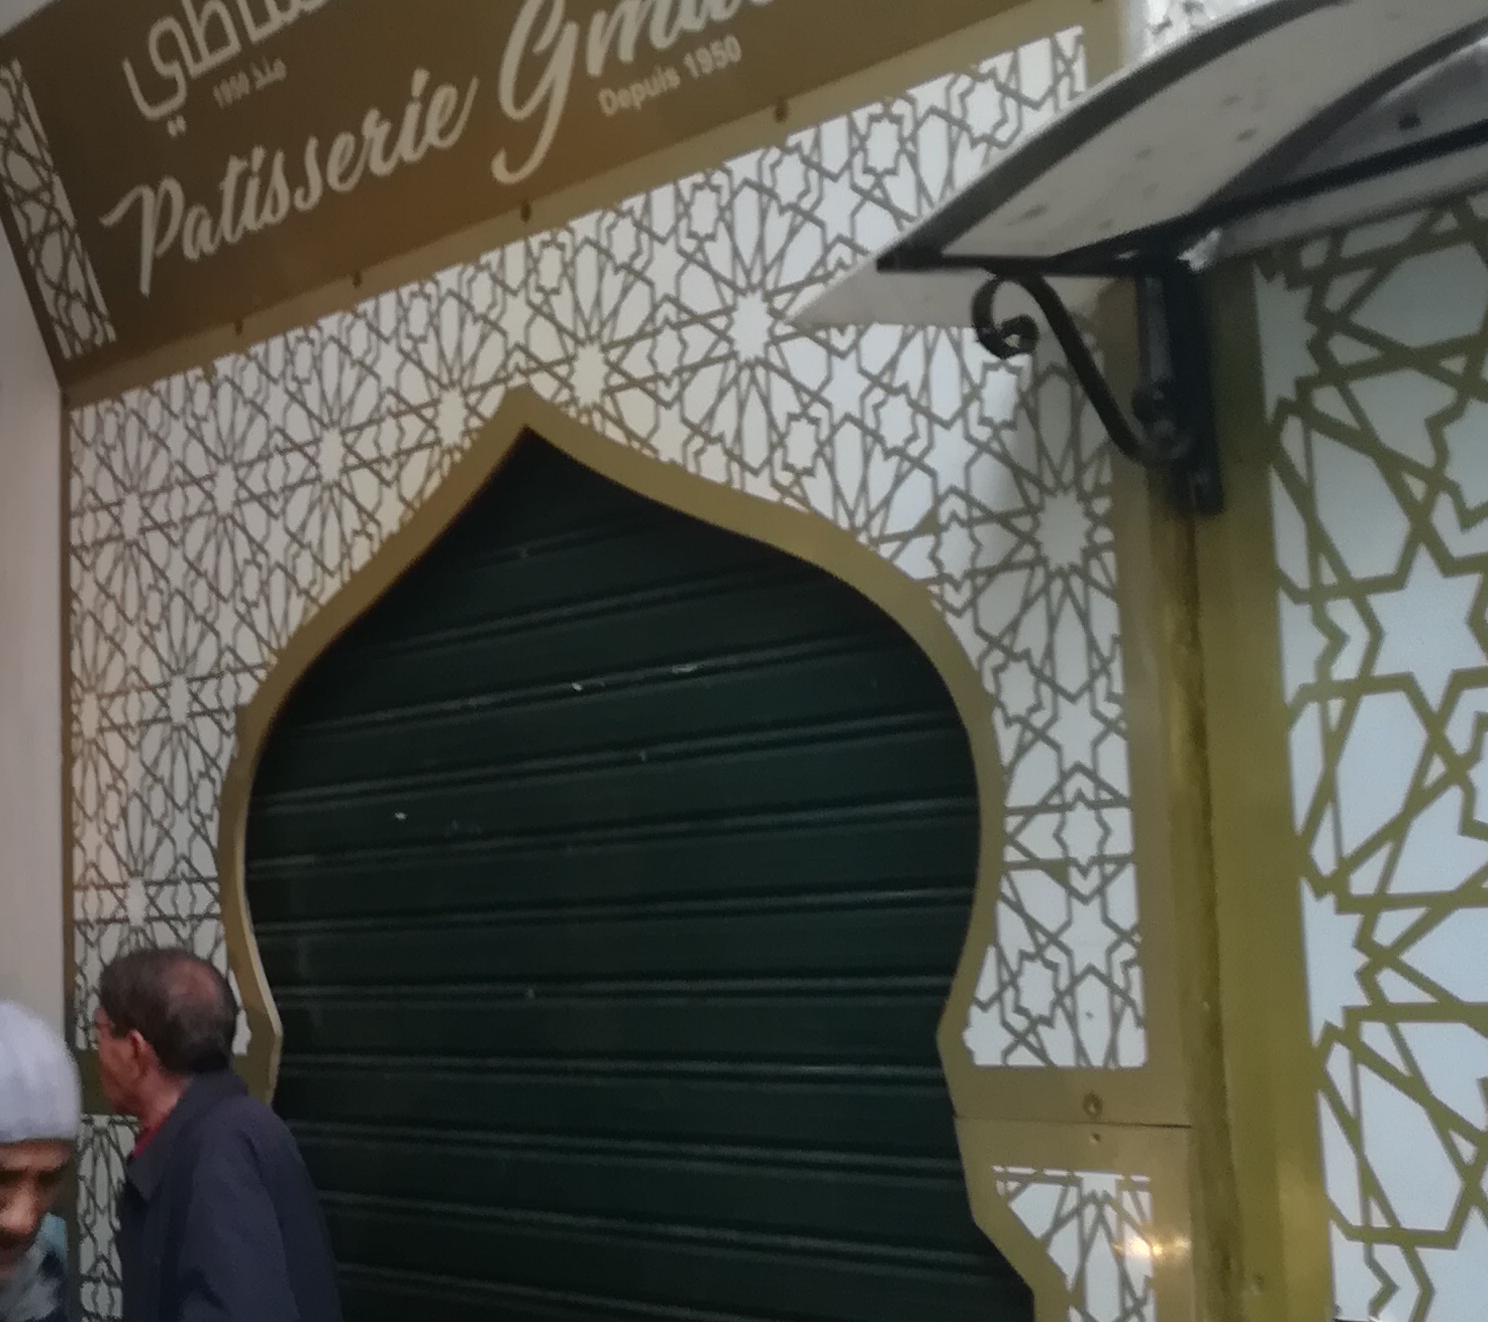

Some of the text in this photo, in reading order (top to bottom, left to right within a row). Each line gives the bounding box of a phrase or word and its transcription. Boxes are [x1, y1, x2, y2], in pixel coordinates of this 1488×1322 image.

[598, 34, 743, 117] Depuis 1950
[99, 67, 479, 297] Patisserie
